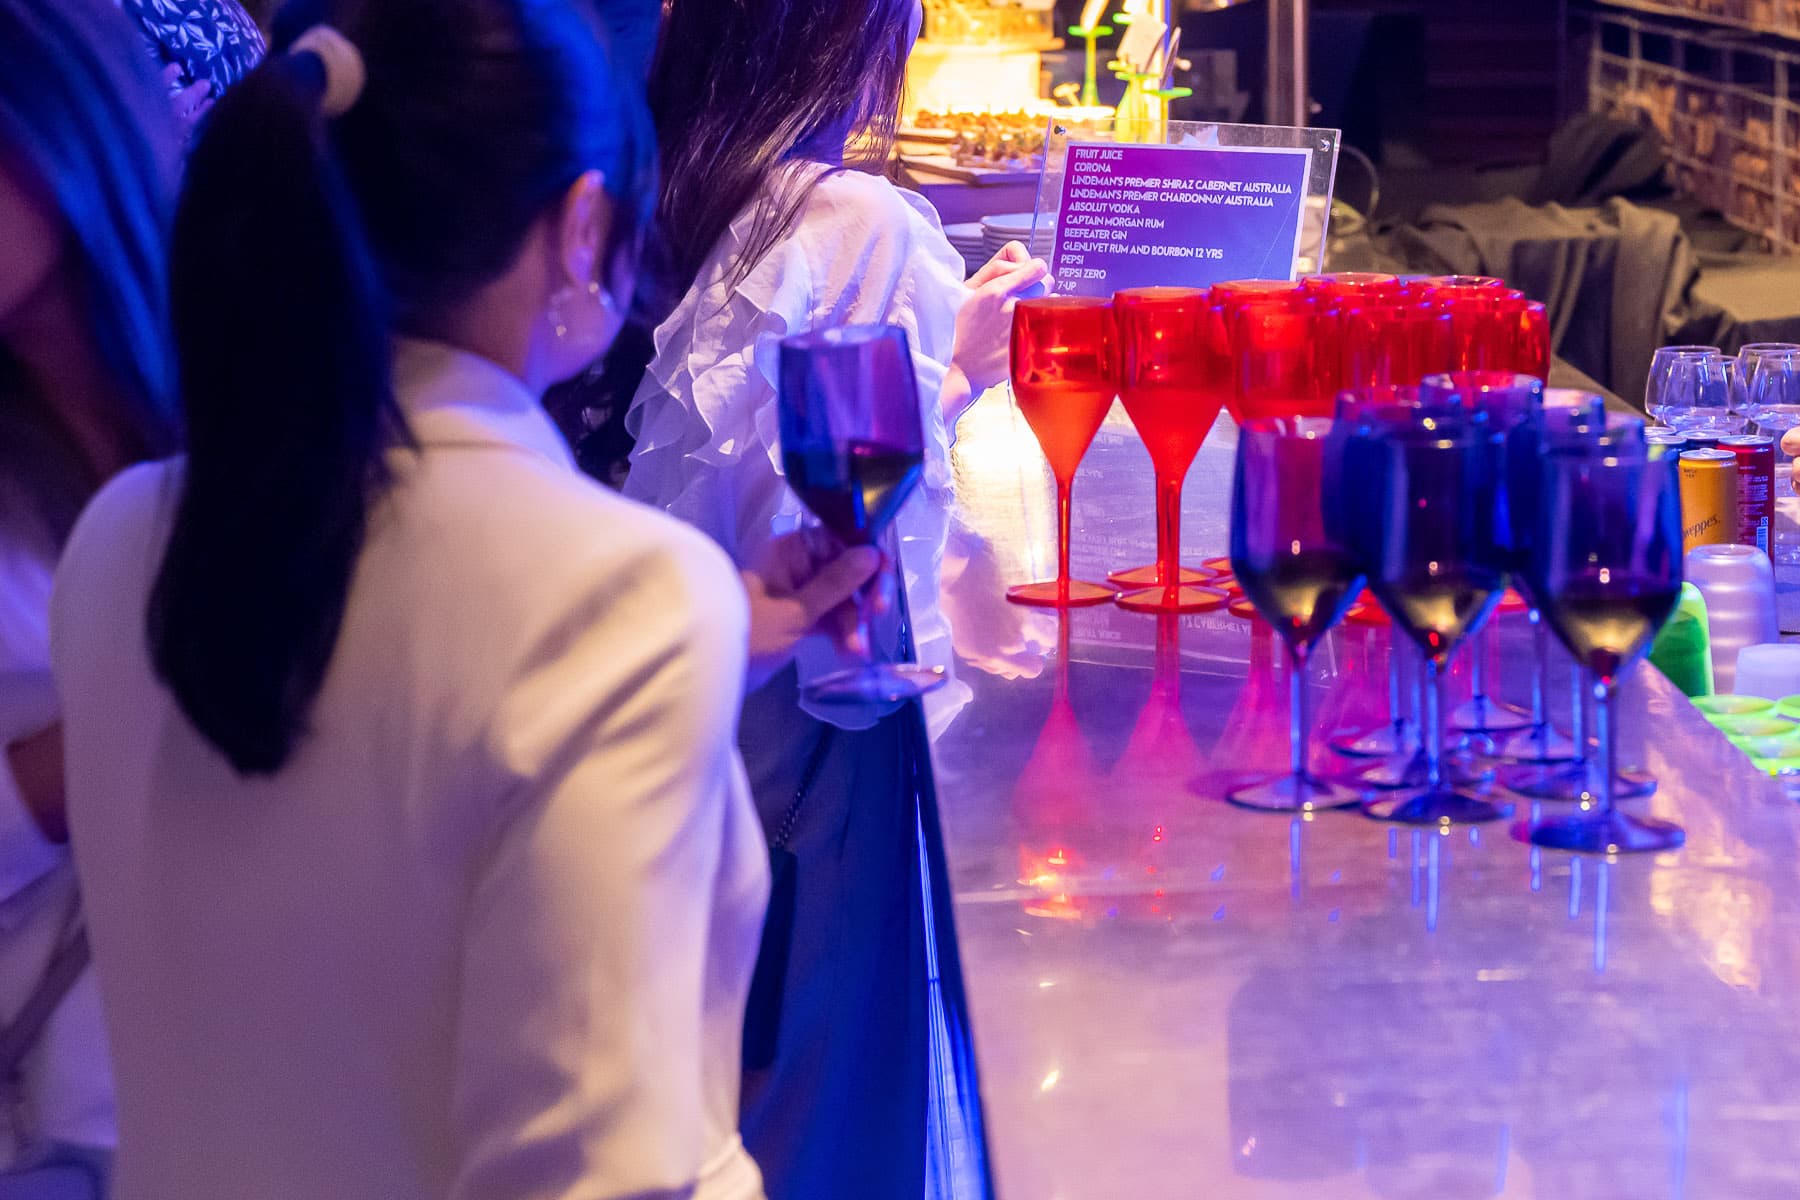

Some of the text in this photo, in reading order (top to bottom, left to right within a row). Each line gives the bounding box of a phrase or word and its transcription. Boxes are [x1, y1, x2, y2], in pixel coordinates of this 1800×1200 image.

[1076, 149, 1123, 160] FRUIT JUICE
[1074, 162, 1111, 173] CORONA
[1072, 176, 1292, 194] LINDEMAN'S PREMIER SHIRAZ CABERNET AUSTRALIA
[1070, 189, 1273, 207] LINDEMAN'S PREMIER CHARDONNAY AUSTRALIA
[1068, 202, 1140, 214] ABSOLUT VODKA
[1066, 215, 1164, 229] CAPTAIN MORGAN RUM
[1064, 228, 1127, 240] BEEFEATER GIN
[1063, 241, 1223, 259] GLENLIVET RUM AND BOURBON 12 YRS
[1060, 254, 1084, 264] PEPSI
[1059, 267, 1106, 279] PEPSI ZERO
[1058, 281, 1077, 290] 7-UP
